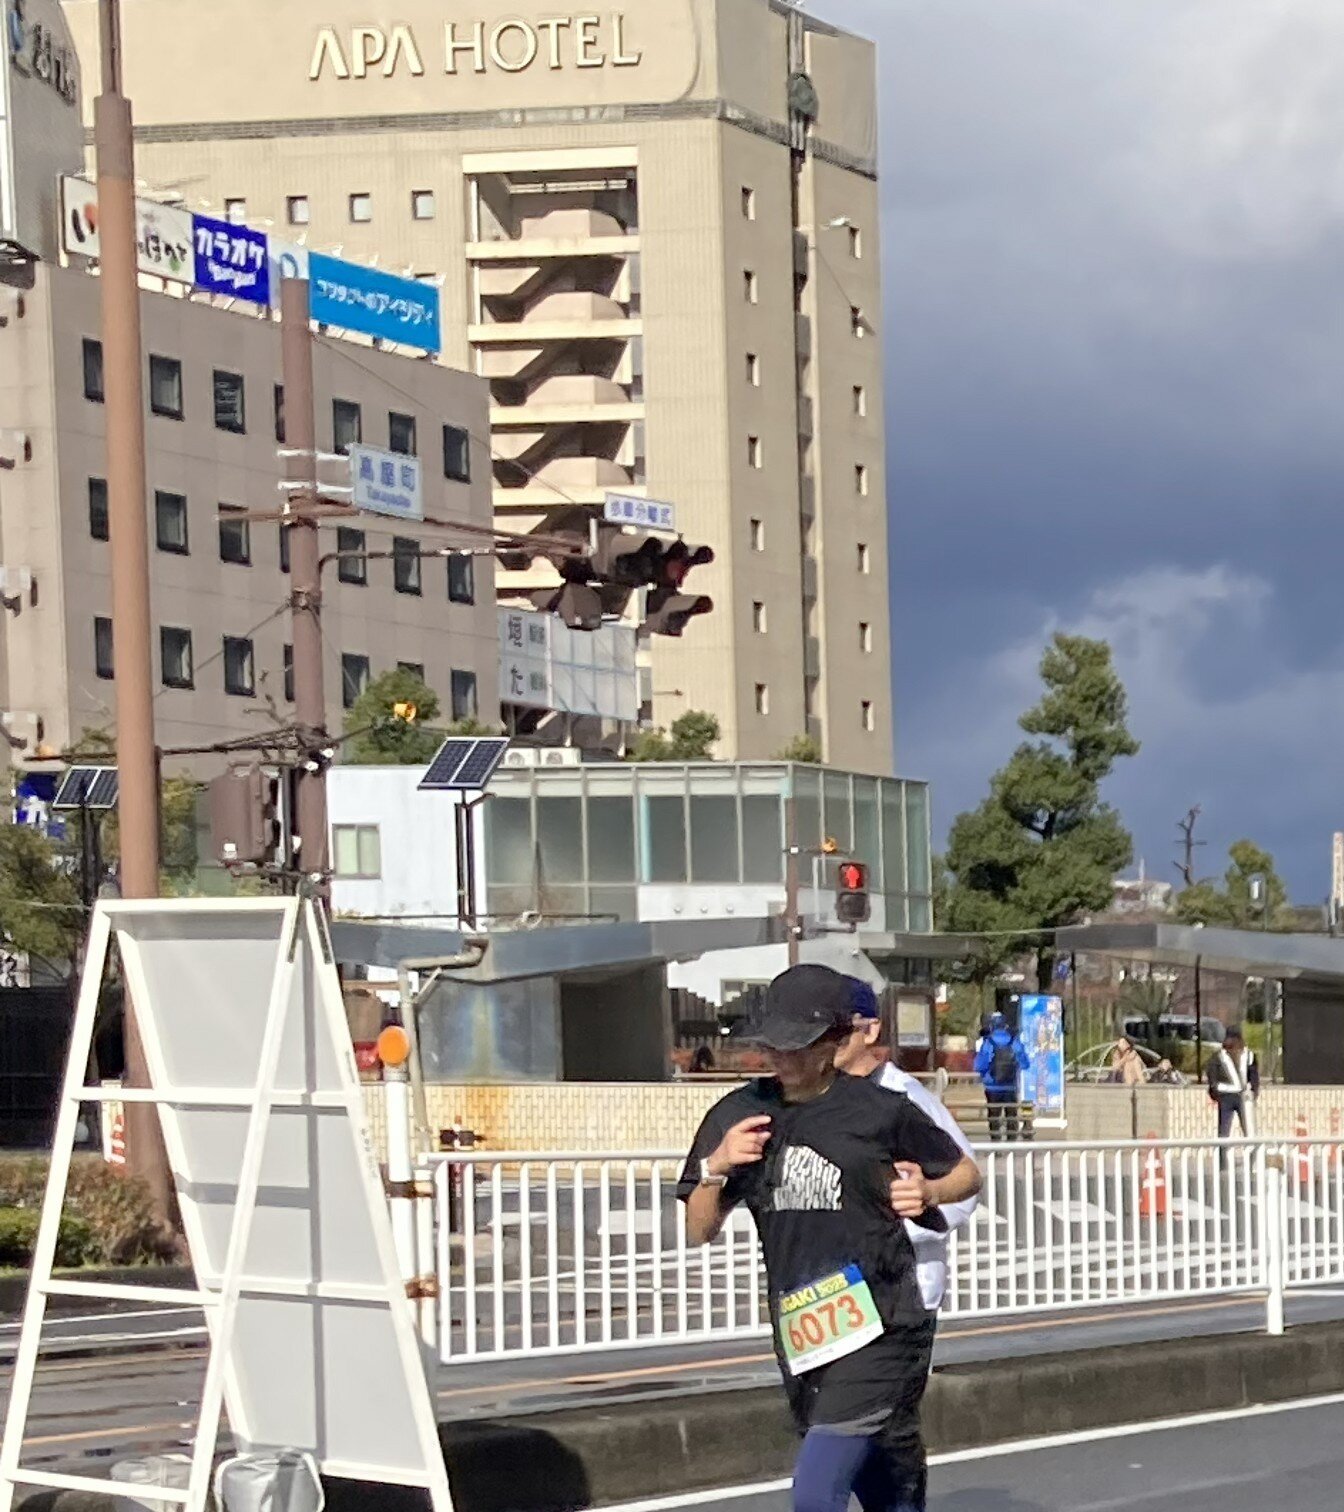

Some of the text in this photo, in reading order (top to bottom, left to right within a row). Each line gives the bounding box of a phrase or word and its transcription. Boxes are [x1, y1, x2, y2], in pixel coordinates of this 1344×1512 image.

[308, 12, 642, 81] APA HOTEL
[196, 226, 265, 269] カラオケ
[788, 1293, 866, 1353] 6073
